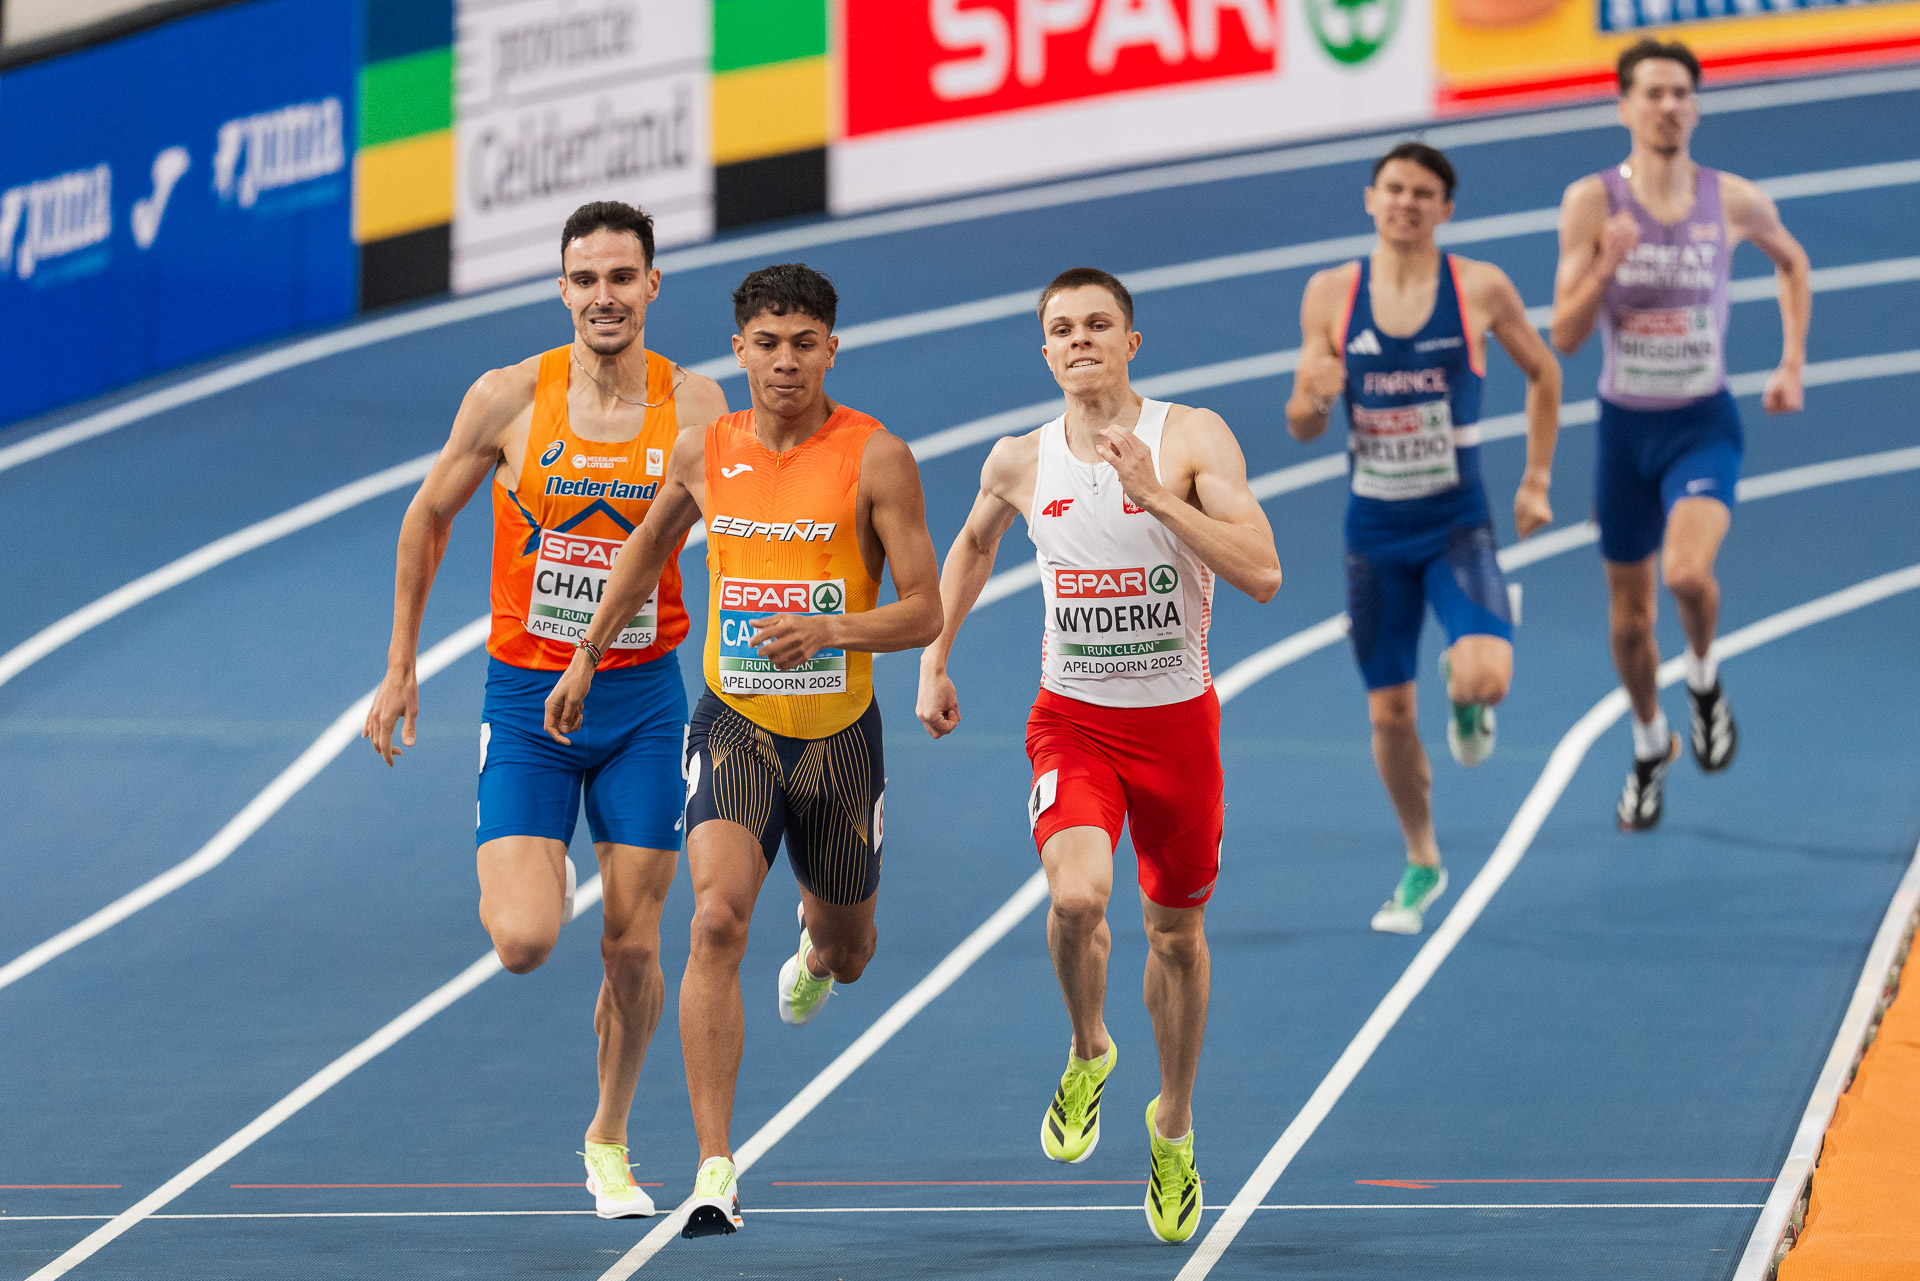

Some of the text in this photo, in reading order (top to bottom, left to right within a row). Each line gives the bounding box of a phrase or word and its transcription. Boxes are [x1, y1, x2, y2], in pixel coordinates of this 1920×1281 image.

[545, 475, 659, 500] Nederland
[1042, 499, 1075, 517] 4F
[709, 514, 838, 542] ESPAÑA
[1058, 571, 1144, 594] SPAR
[723, 585, 807, 609] SPAR
[562, 609, 589, 622] RUN
[1055, 601, 1182, 633] WYDERKA
[621, 632, 652, 644] 2025
[1088, 646, 1112, 655] RUN
[745, 660, 771, 671] RUN
[1062, 655, 1183, 674] APELDOORN 2025
[722, 676, 841, 690] APELDOORN 2025
